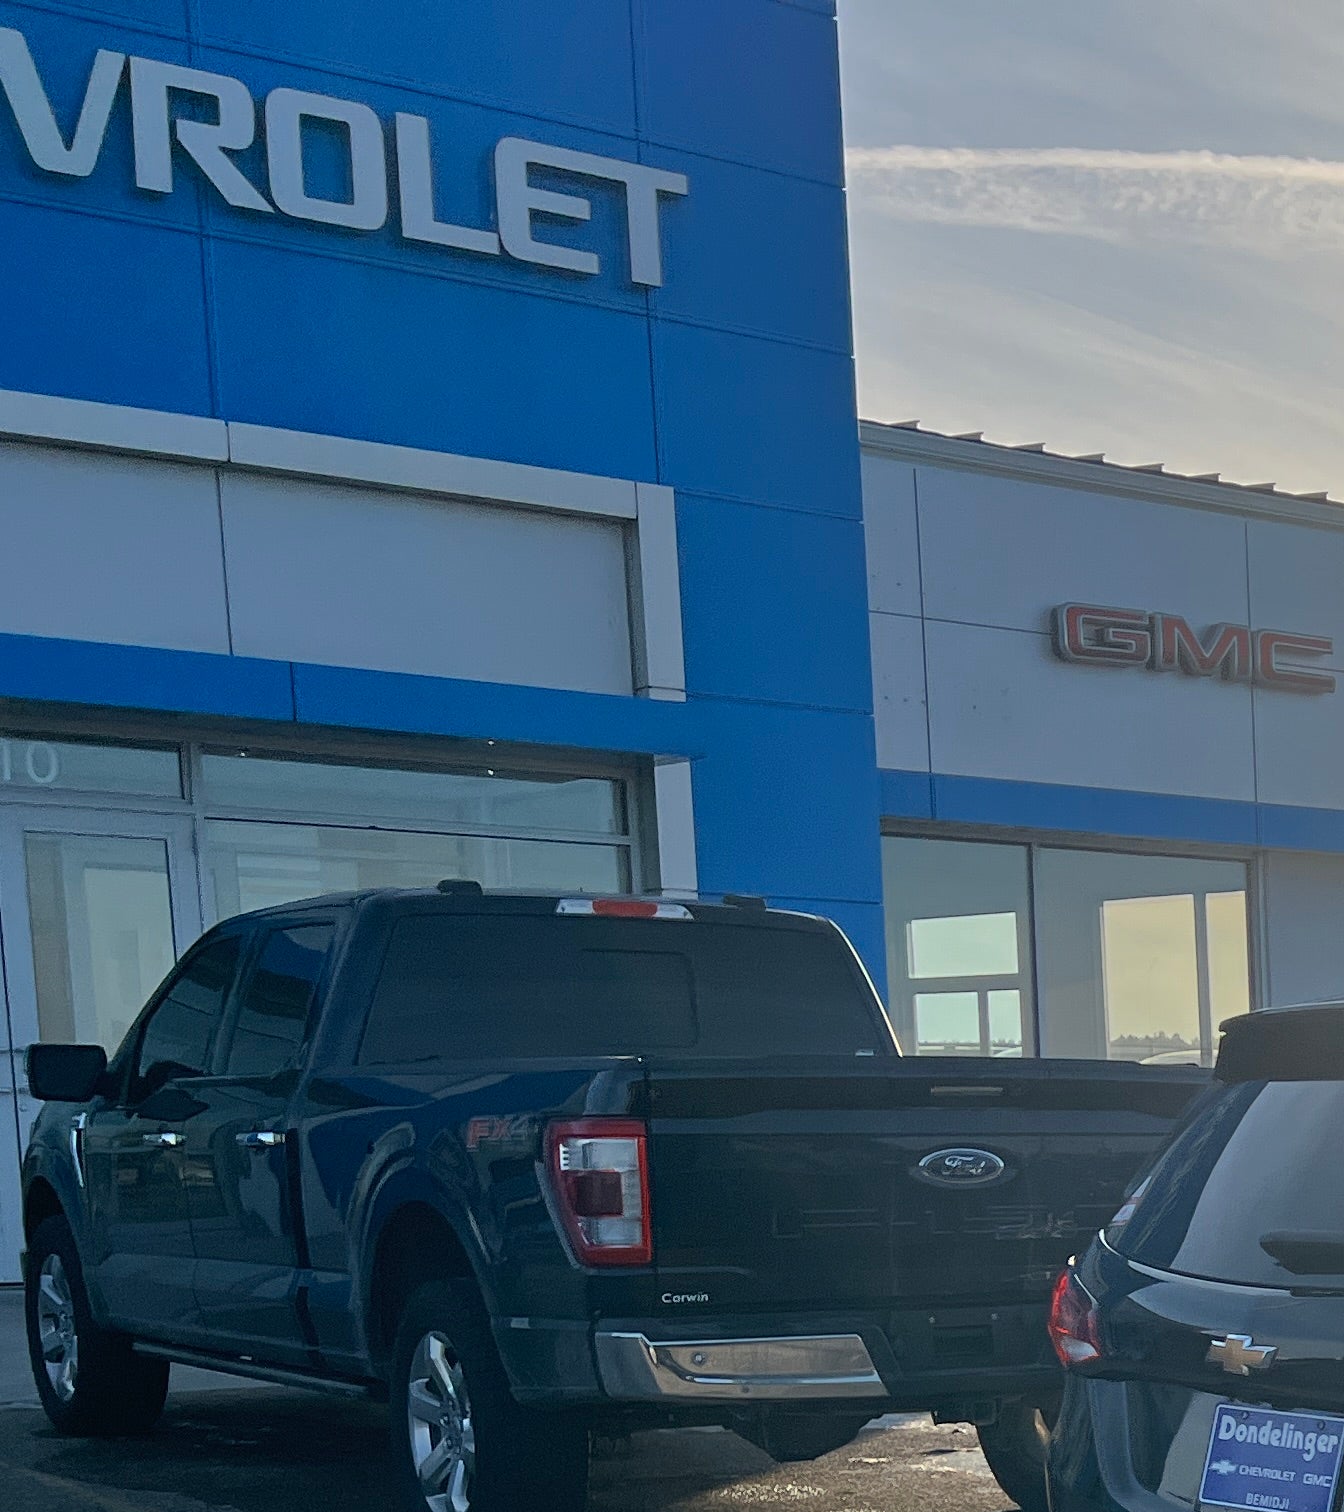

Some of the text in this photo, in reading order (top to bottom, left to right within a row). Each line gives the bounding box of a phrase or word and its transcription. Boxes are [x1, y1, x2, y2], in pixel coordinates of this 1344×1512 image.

[0, 27, 689, 288] VROLET
[1051, 602, 1336, 693] GMC
[466, 1115, 529, 1152] FX4
[661, 1292, 710, 1304] Carwin
[1218, 1414, 1339, 1462] Dondelinger
[1238, 1464, 1333, 1488] CHEVROLET GMC
[1245, 1492, 1290, 1510] BEMIDJI
